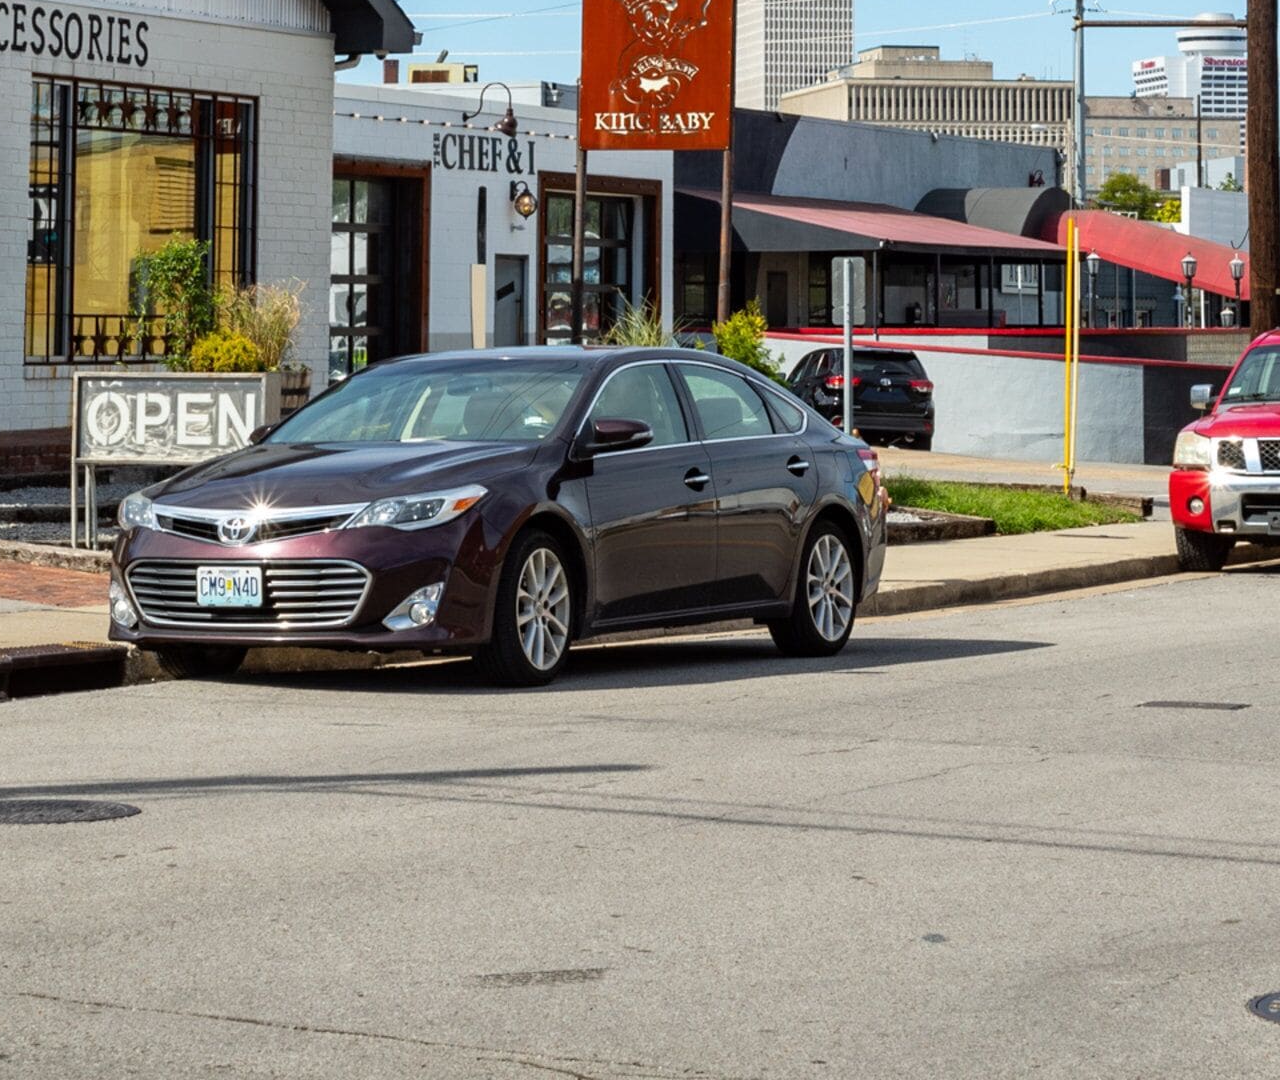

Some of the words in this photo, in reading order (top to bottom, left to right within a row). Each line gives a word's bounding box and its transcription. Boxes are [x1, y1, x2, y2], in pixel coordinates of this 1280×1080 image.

[659, 112, 715, 130] BABY
[441, 133, 502, 172] CHEF
[505, 138, 524, 174] &
[527, 140, 536, 175] I
[87, 391, 256, 446] OPEN
[200, 576, 225, 597] CM9
